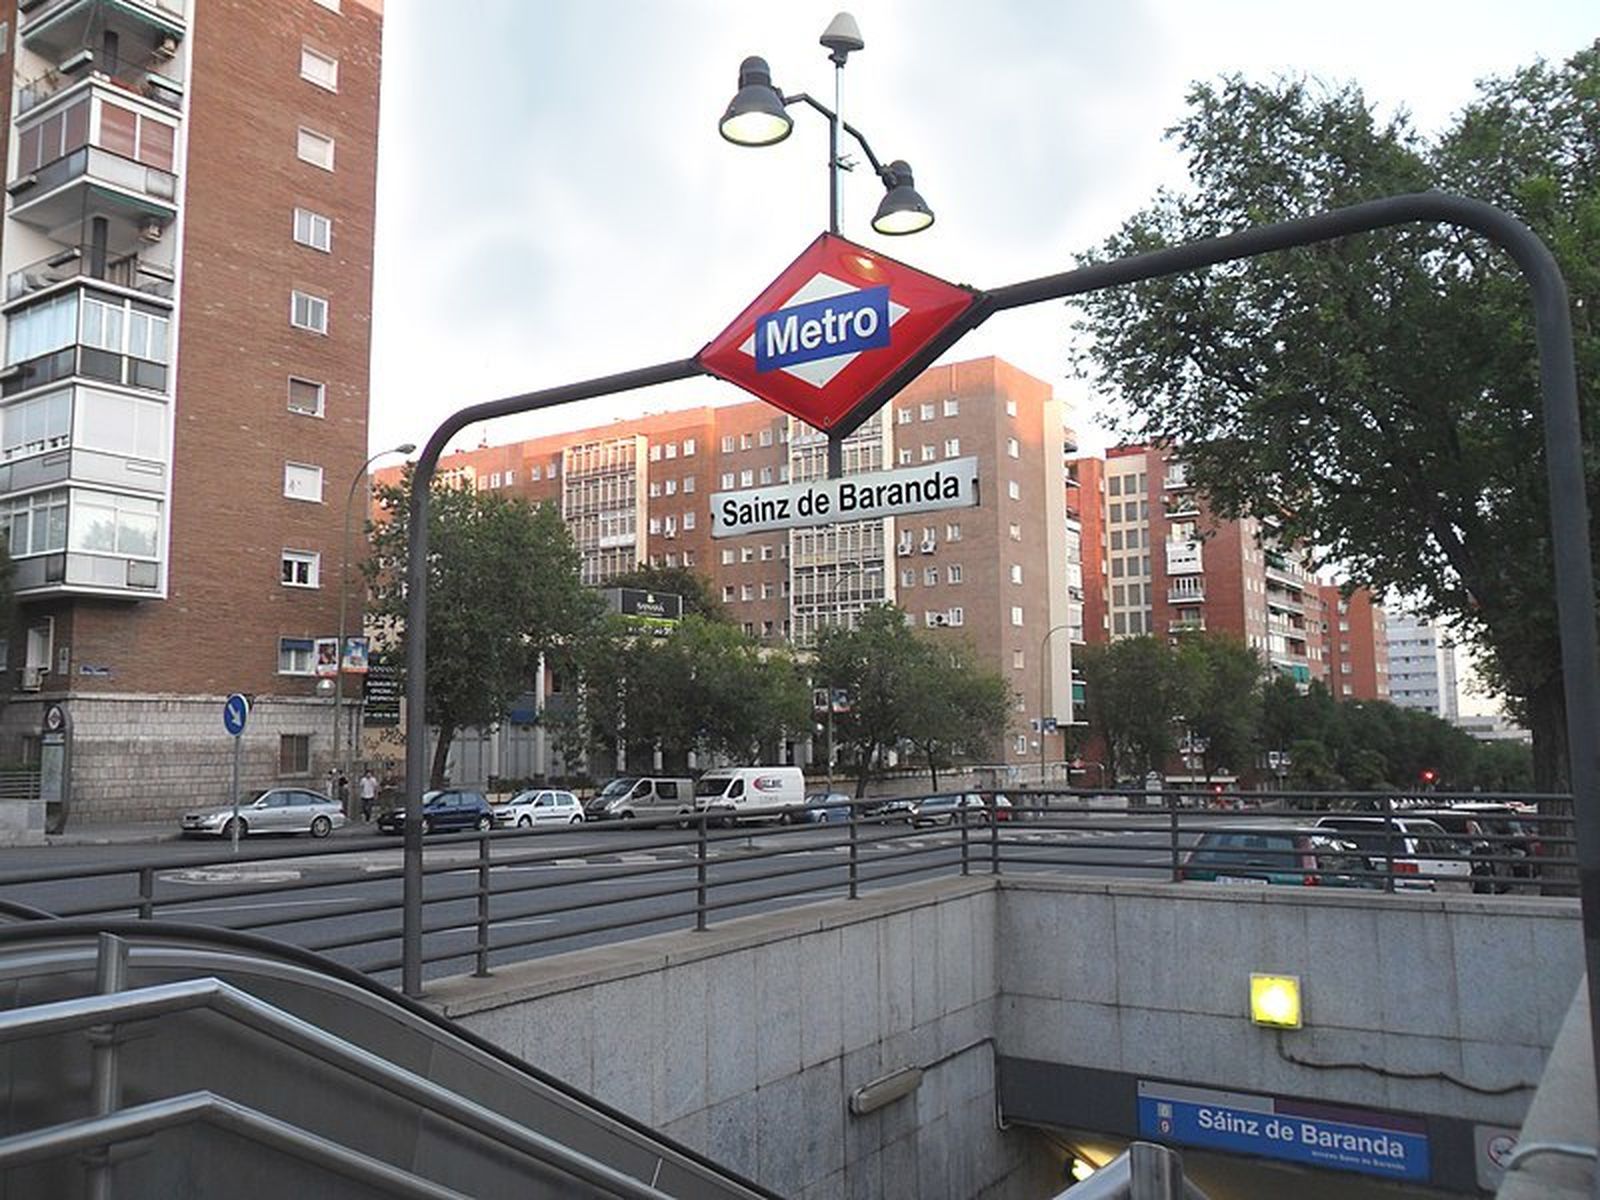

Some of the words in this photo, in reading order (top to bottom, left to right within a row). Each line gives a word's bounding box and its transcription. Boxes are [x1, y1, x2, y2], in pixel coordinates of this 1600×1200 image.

[767, 307, 879, 358] Metro
[722, 495, 791, 527] Sainz
[797, 489, 830, 516] de
[839, 471, 960, 512] Baranda
[1198, 1108, 1260, 1136] Sáinz
[1265, 1120, 1294, 1141] de
[1301, 1123, 1405, 1159] Baranda
